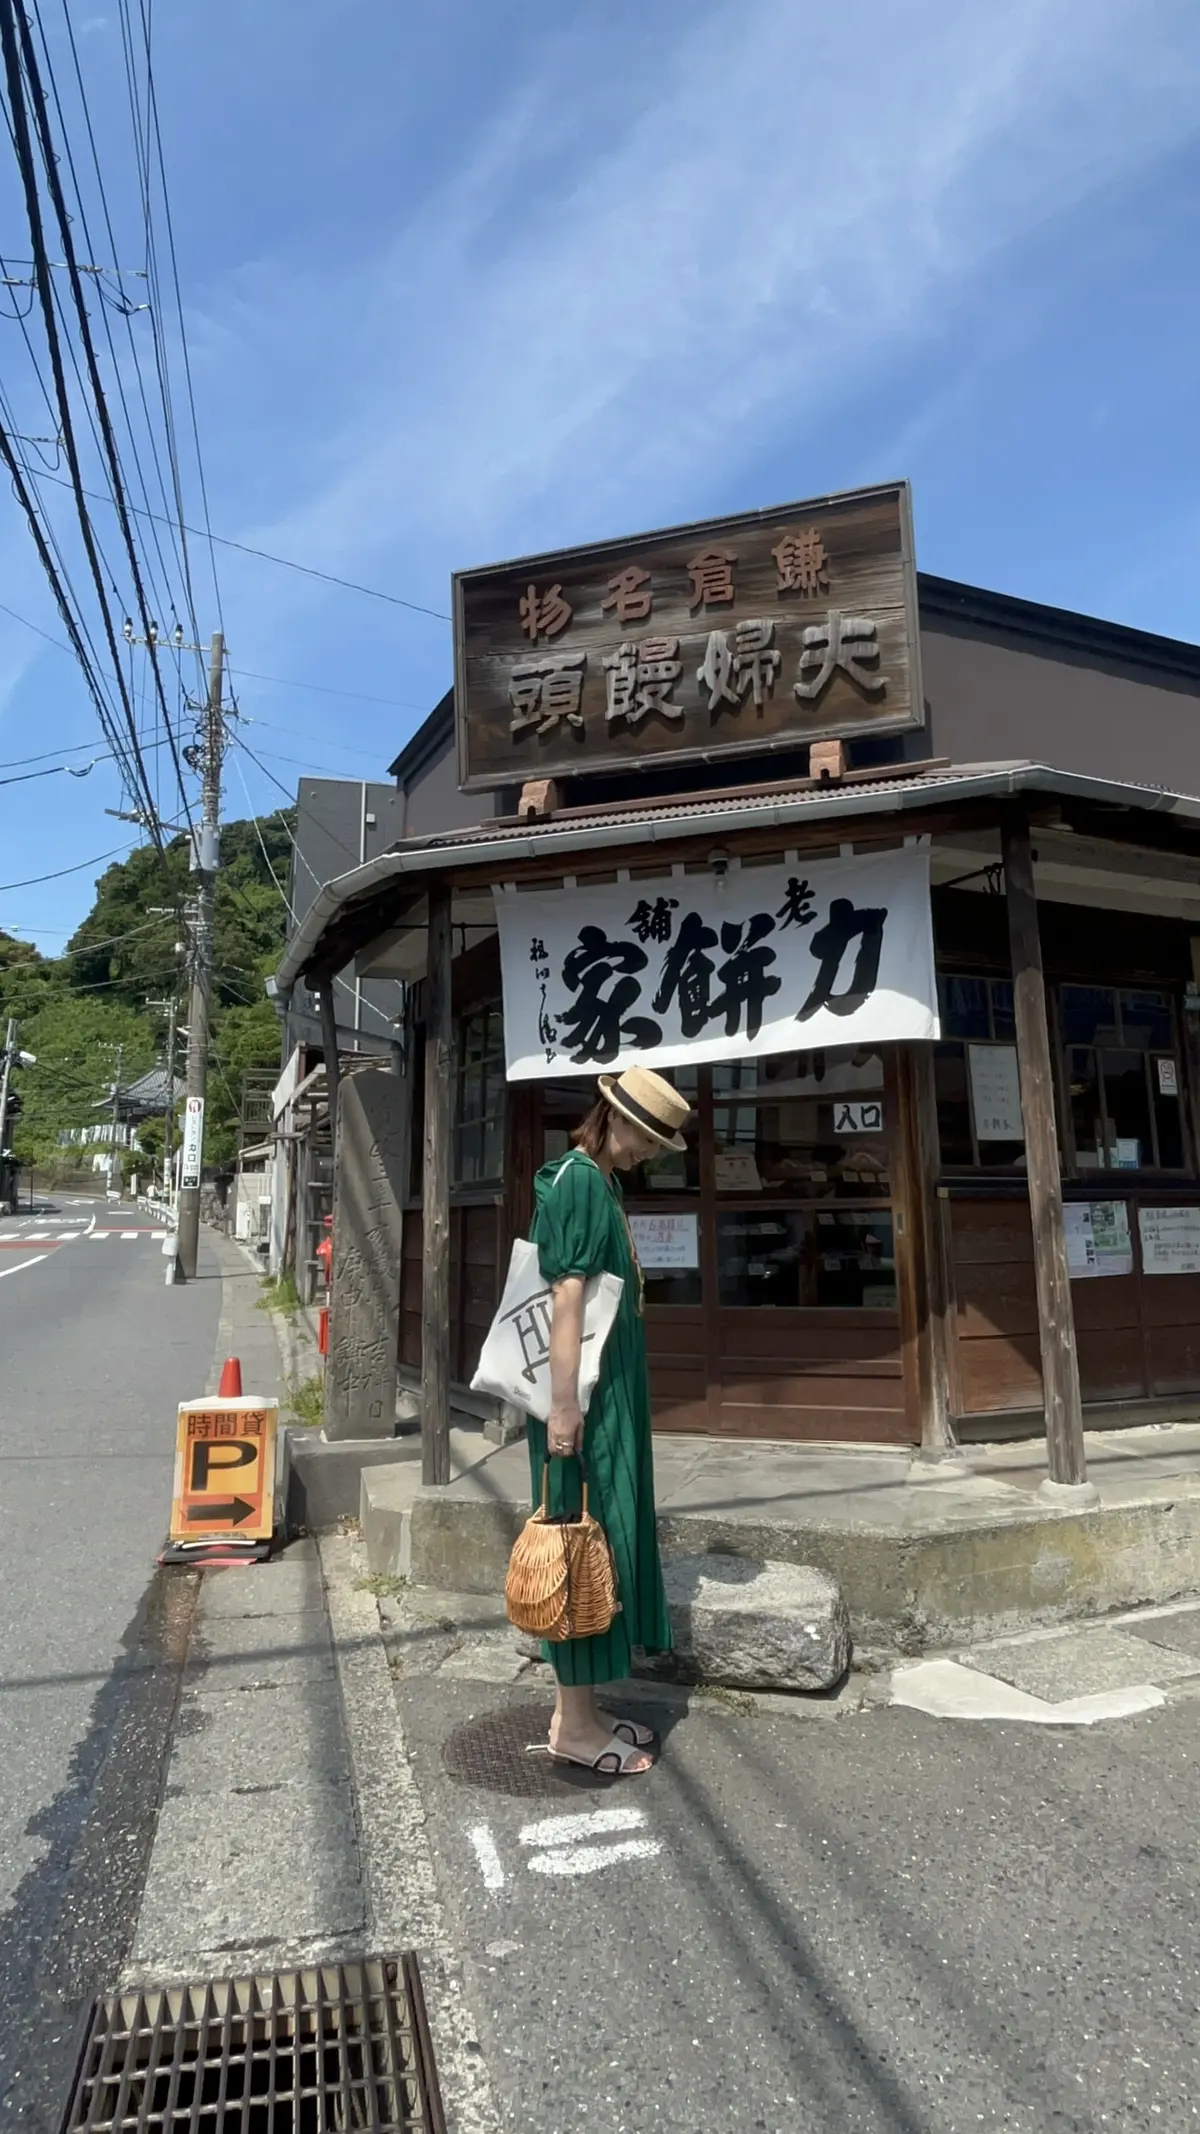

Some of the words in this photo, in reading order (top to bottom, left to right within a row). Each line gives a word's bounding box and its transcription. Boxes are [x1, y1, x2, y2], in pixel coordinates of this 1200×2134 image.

[836, 1103, 881, 1131] 入口
[187, 1411, 265, 1437] 時間貸
[191, 1440, 258, 1490] P
